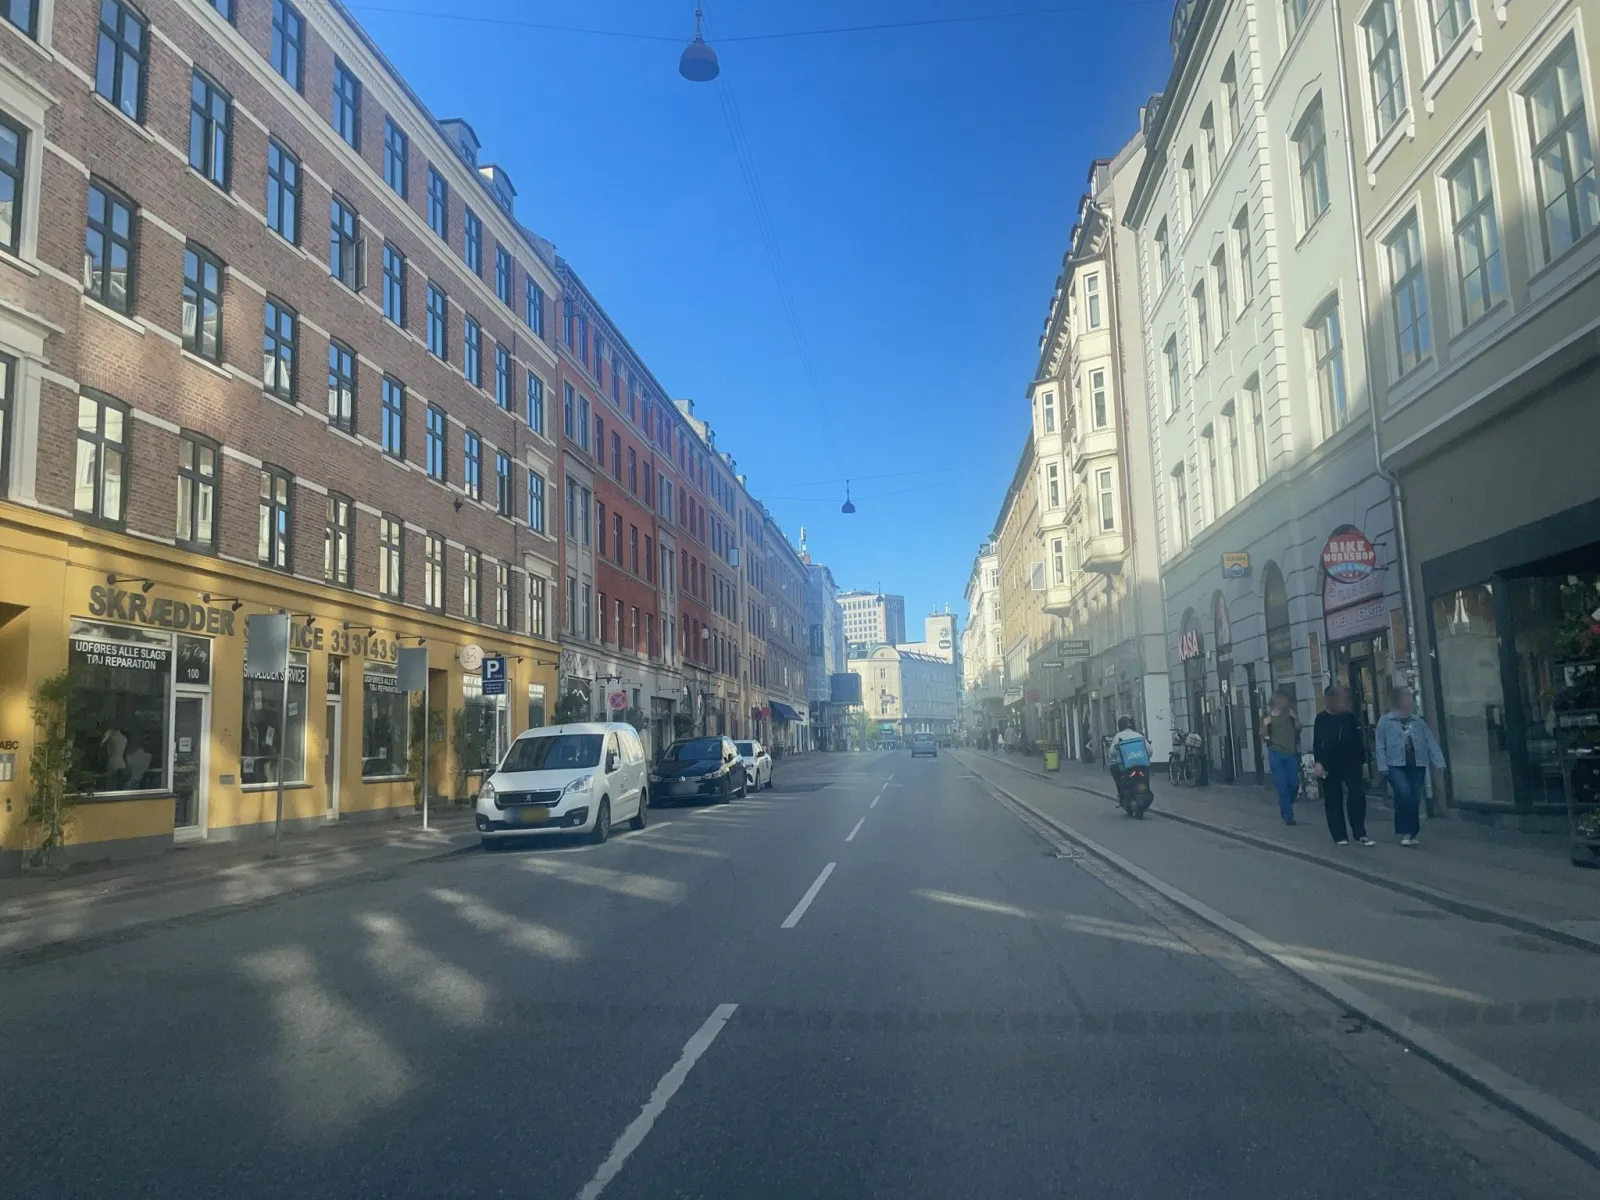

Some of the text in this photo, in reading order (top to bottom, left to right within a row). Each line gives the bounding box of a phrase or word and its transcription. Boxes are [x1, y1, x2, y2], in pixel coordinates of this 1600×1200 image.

[1329, 541, 1366, 552] BIKE
[1323, 551, 1375, 562] WORKSHOP
[88, 585, 234, 636] SKRÆDDER
[75, 640, 167, 661] UDFØRES ALLE SLAGS
[1178, 630, 1199, 661] KASA
[86, 653, 157, 670] TØJ REPARATION
[187, 668, 200, 680] 100
[487, 660, 499, 679] P
[383, 678, 394, 686] ALLE
[0, 740, 19, 750] ABC
